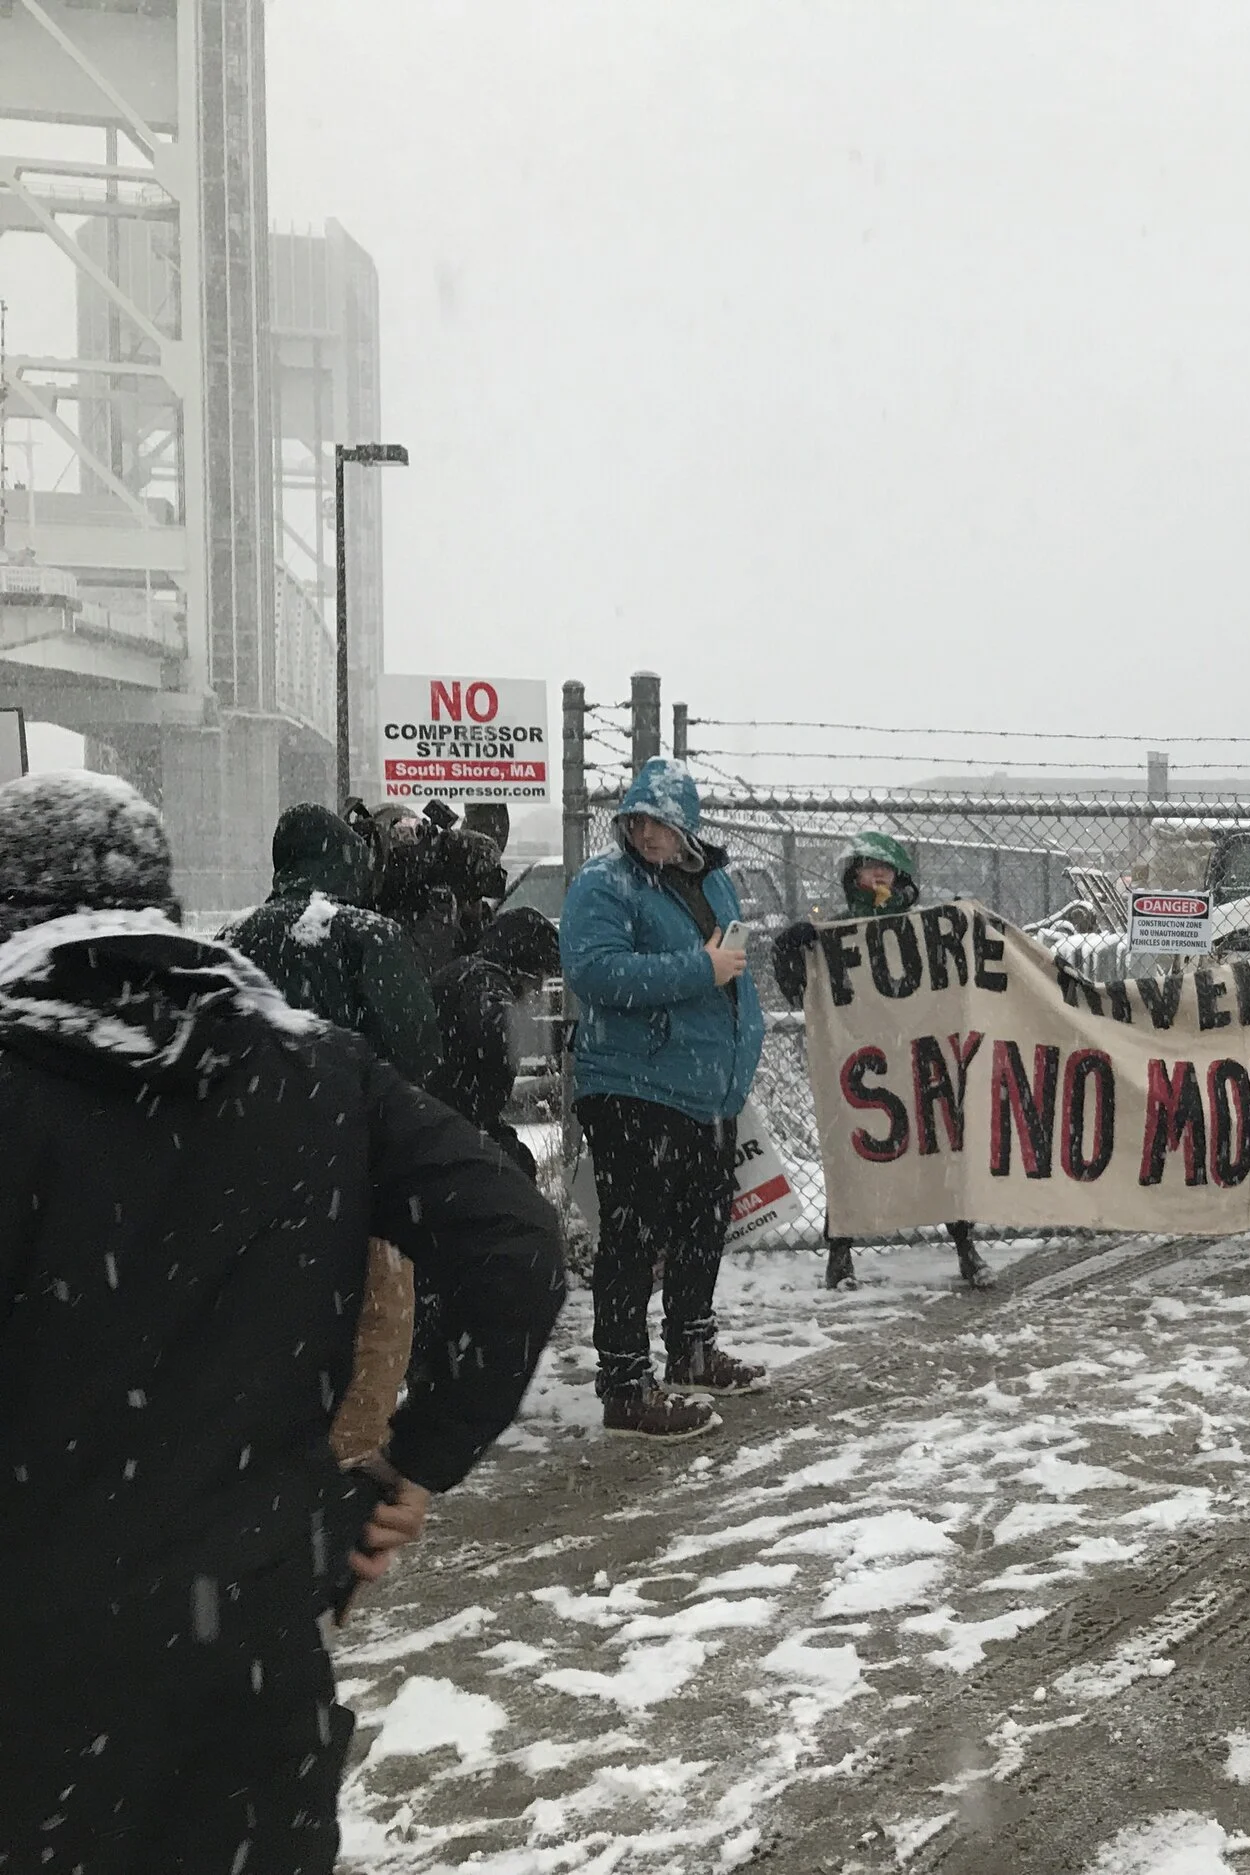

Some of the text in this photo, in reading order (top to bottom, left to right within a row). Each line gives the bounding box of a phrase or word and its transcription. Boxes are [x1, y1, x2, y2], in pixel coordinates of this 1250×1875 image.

[430, 680, 499, 723] NO
[384, 724, 544, 743] COMPRESSOR
[416, 742, 515, 758] STATION
[395, 763, 536, 779] South Shore, MA
[386, 783, 546, 798] NOCompressor.com
[1143, 900, 1198, 913] DANGER
[1138, 919, 1202, 929] CONSTRUCTION ZONE
[1140, 929, 1199, 938] NO UNAUTHORIZED
[1131, 938, 1208, 948] VEHICLES OR PERSONNEL
[819, 905, 1008, 1007] FORE
[840, 1031, 985, 1162] SAY
[990, 1040, 1116, 1182] NO
[735, 1193, 762, 1216] MA
